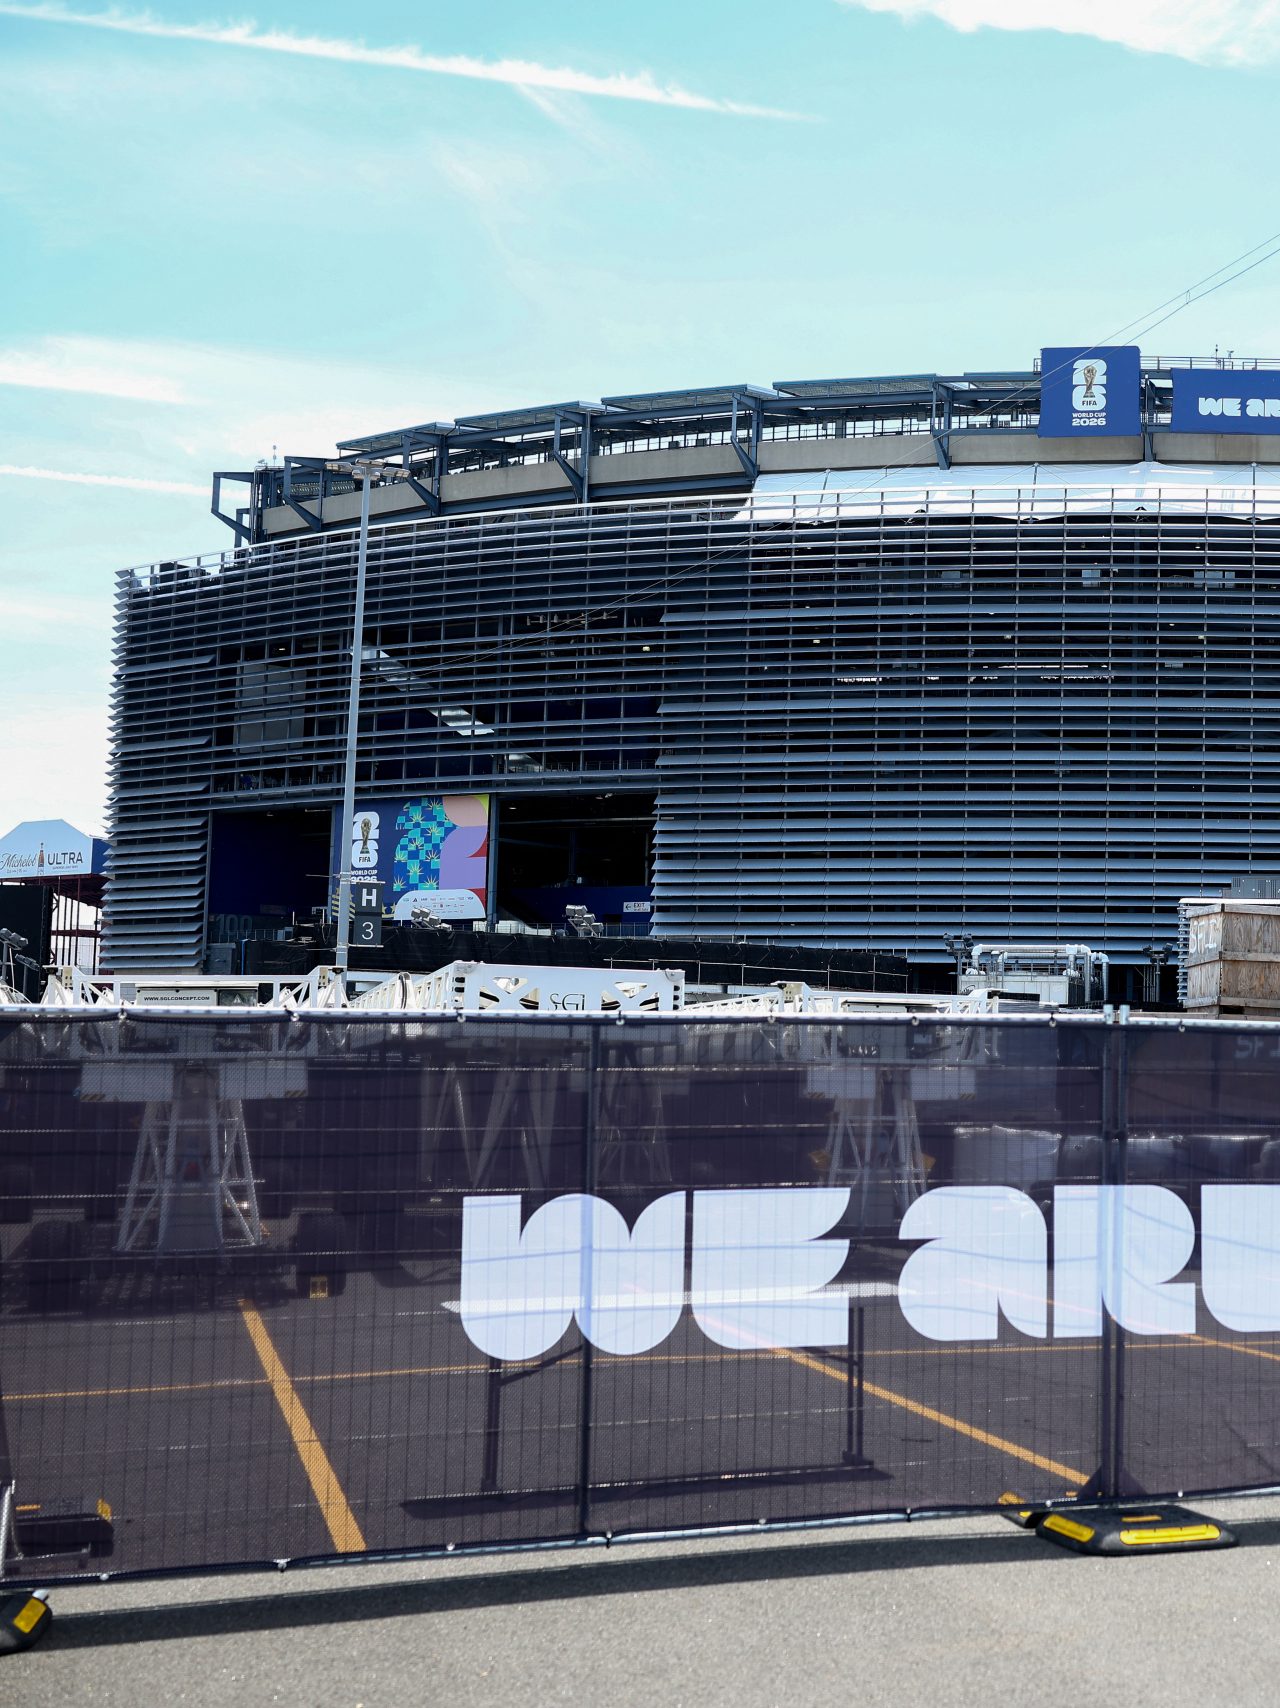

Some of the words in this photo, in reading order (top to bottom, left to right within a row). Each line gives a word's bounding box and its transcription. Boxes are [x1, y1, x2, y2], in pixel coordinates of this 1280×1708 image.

[1198, 398, 1241, 417] WE
[1072, 418, 1106, 426] 2026
[48, 851, 83, 866] ULTRA
[361, 888, 377, 907] H
[361, 922, 374, 940] 3
[460, 1187, 851, 1360] WE
